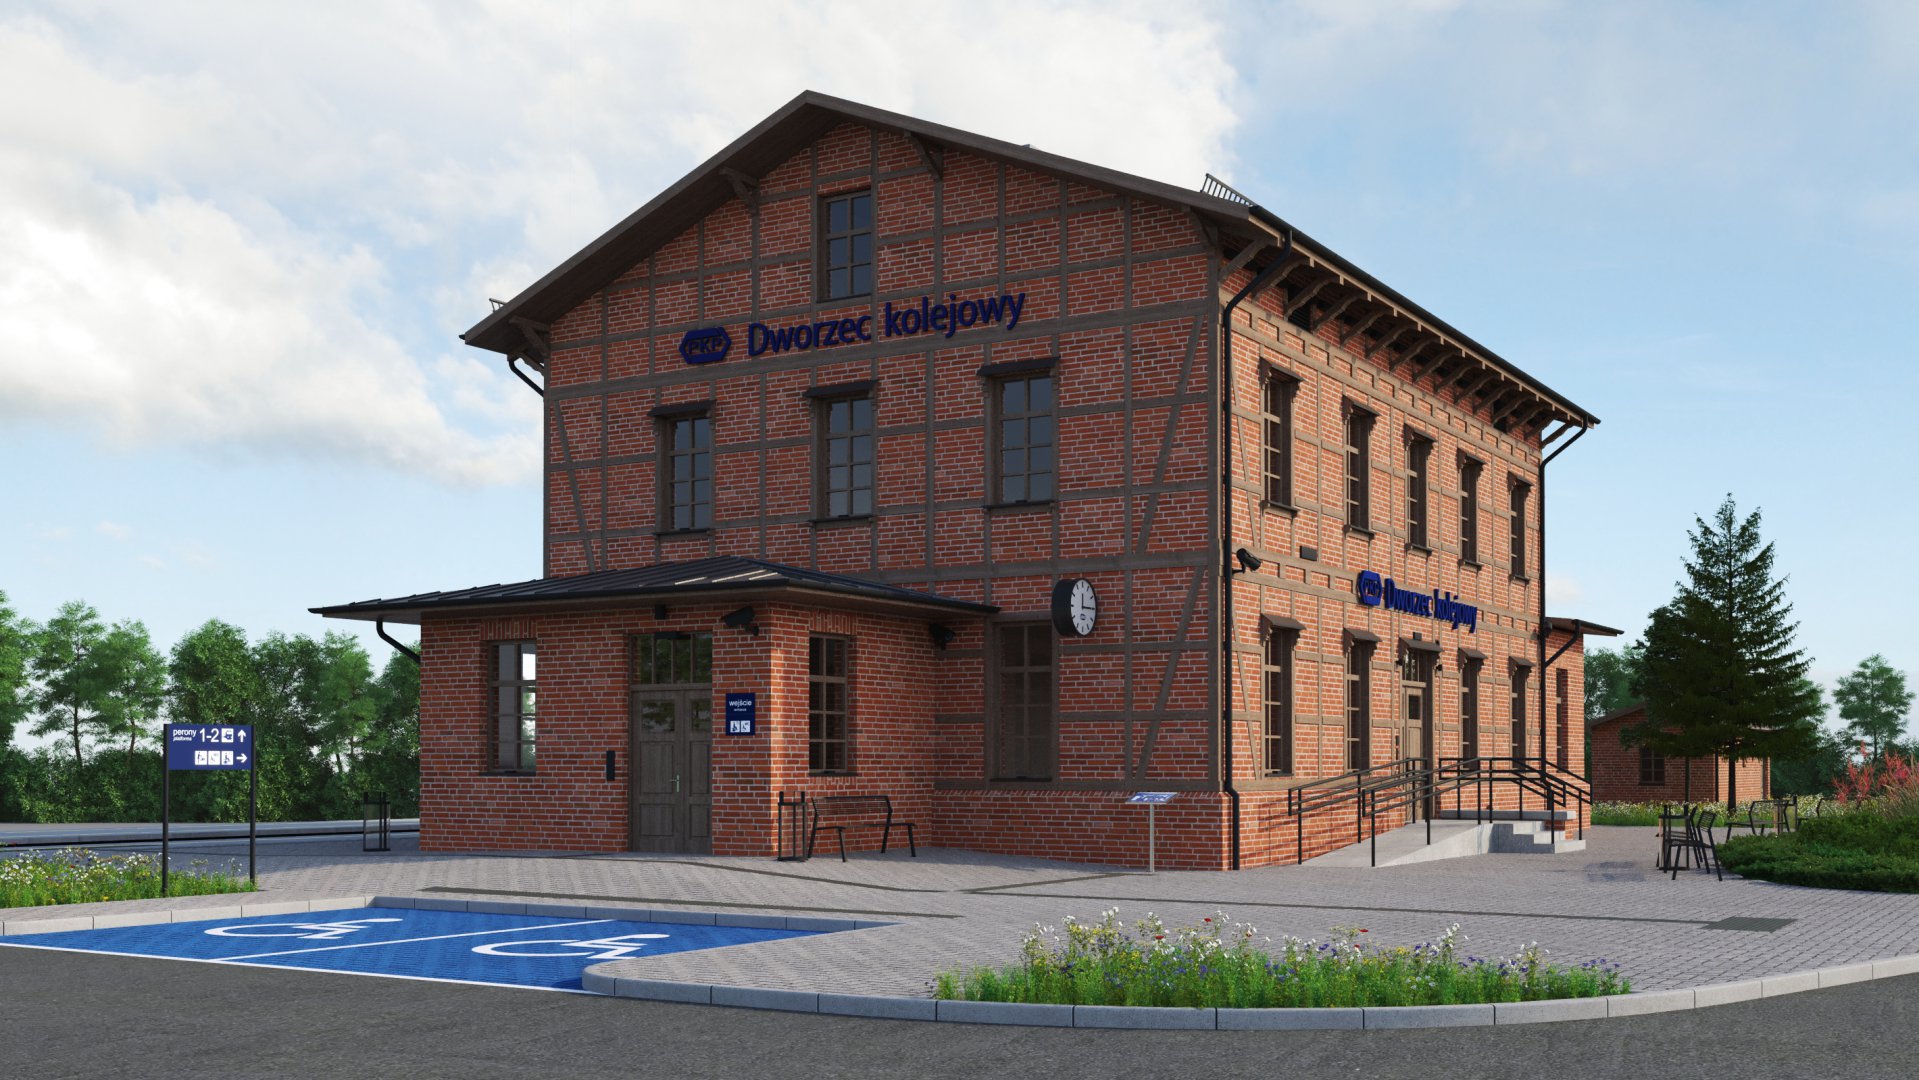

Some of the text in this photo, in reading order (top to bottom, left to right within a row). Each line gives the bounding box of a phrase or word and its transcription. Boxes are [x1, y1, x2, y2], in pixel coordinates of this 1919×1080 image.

[687, 293, 1025, 356] PKP Dworzec kolejowy
[1384, 578, 1433, 617] Dworzec
[1433, 589, 1478, 634] kolejowy
[173, 728, 219, 742] perony 1-2
